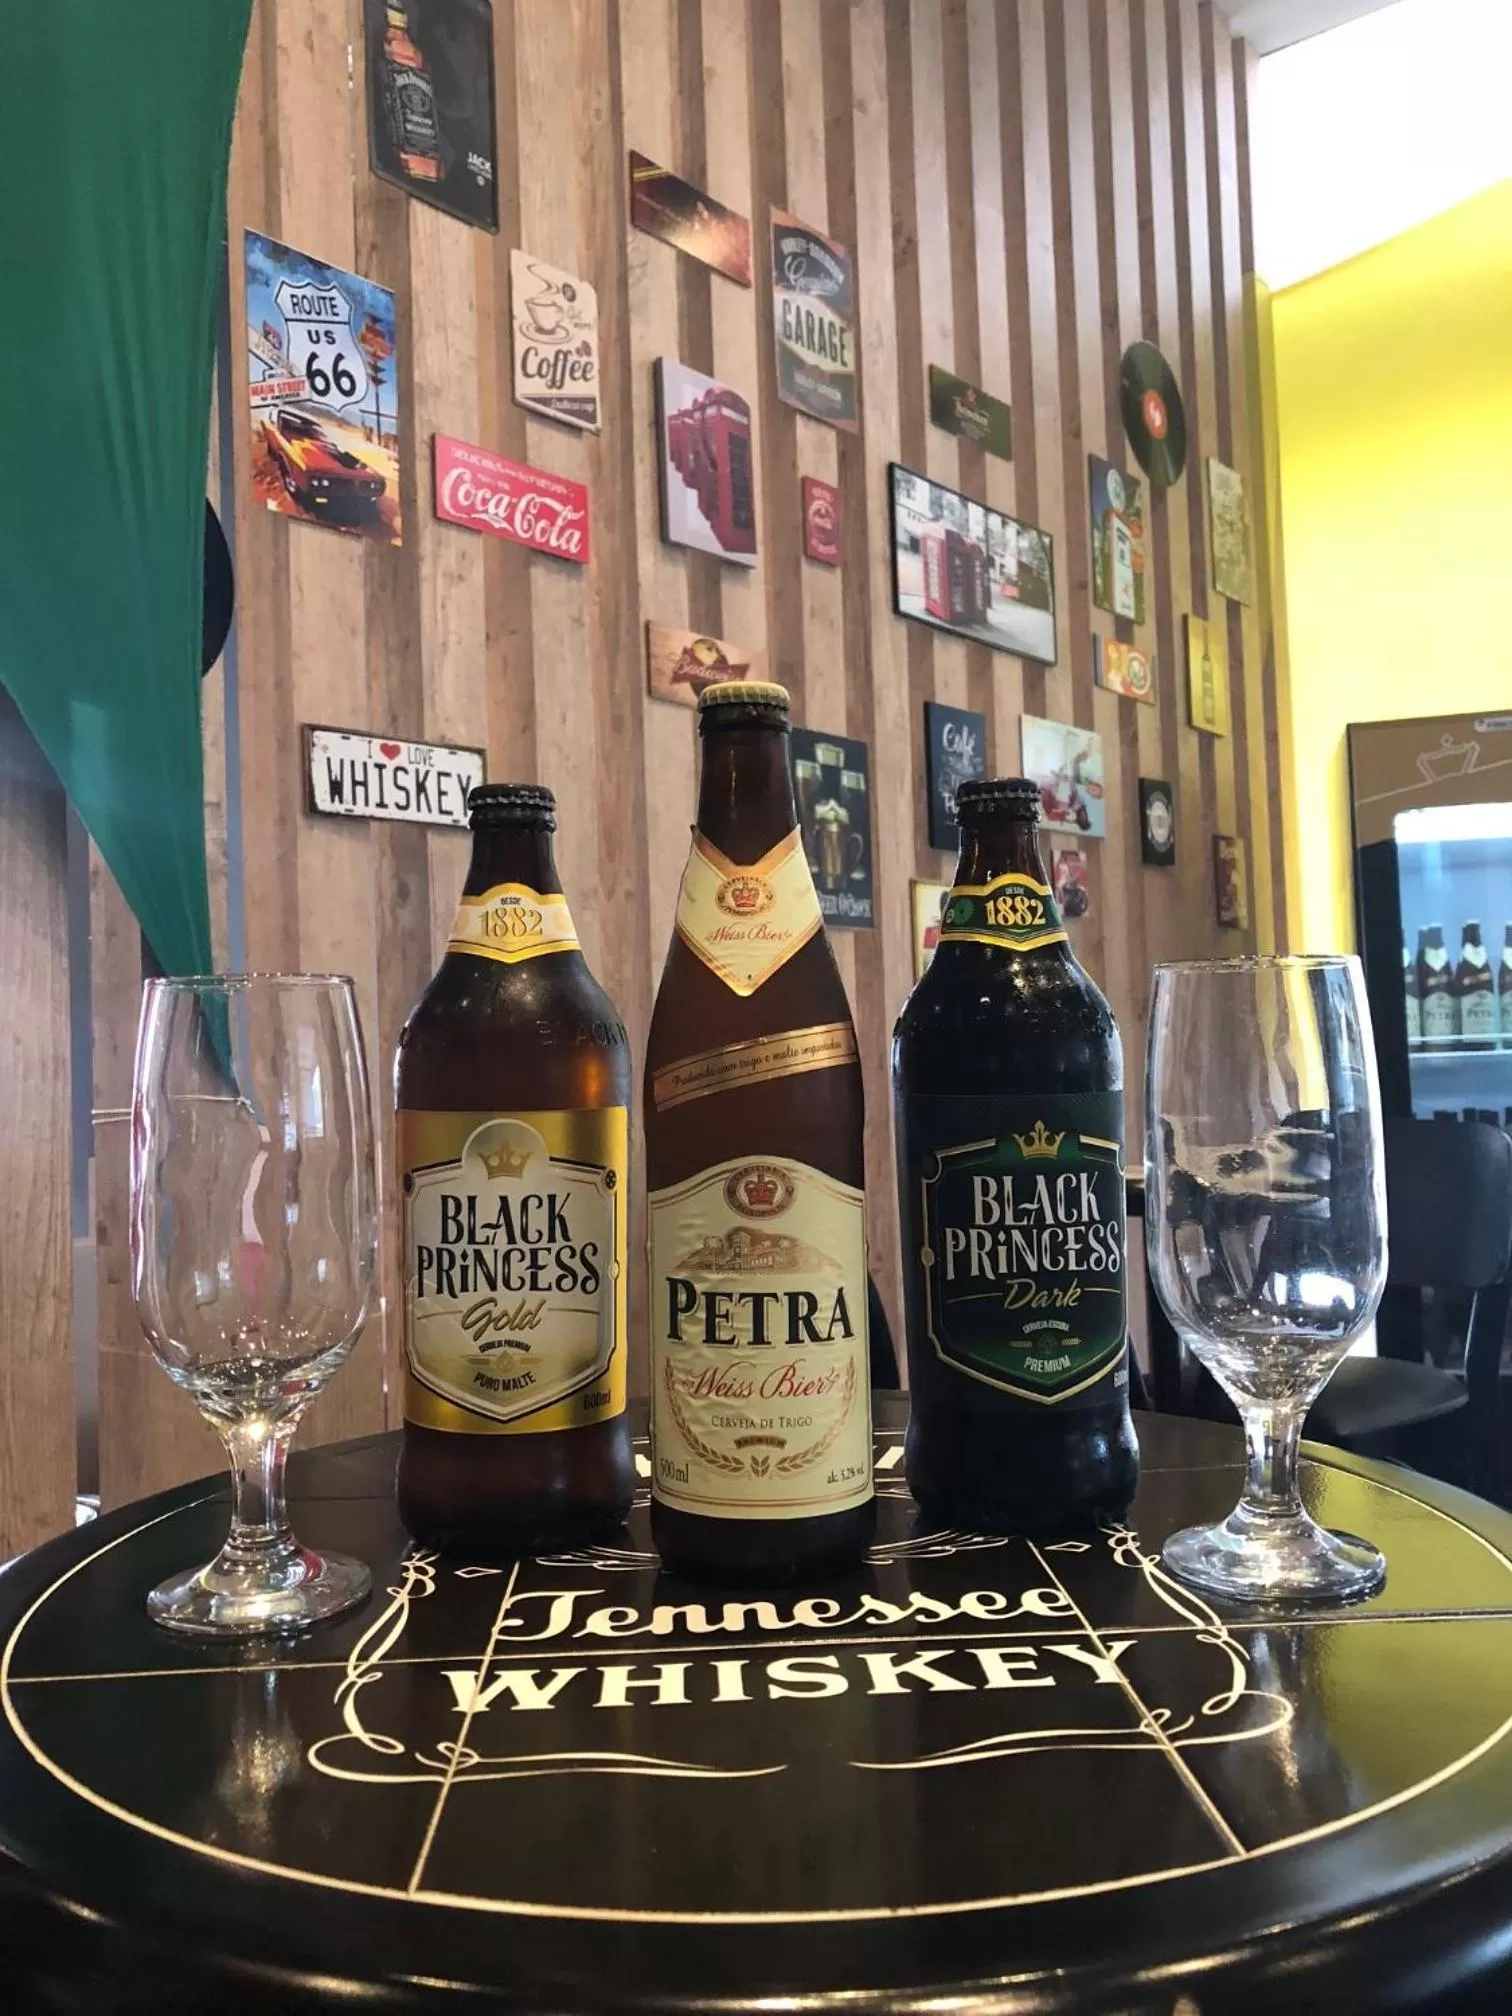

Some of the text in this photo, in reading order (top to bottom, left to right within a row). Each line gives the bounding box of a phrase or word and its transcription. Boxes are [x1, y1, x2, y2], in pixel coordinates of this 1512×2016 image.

[289, 293, 341, 317] ROUTE
[307, 328, 337, 346] US
[781, 297, 848, 368] GARAGE
[305, 351, 357, 398] 66
[520, 346, 596, 390] Coffee
[440, 466, 586, 554] Coca-Cola
[367, 740, 435, 769] I LOVE
[326, 755, 473, 818] WHISKEY
[478, 907, 544, 938] 1882
[704, 920, 746, 944] Weiss
[985, 895, 1046, 927] 1882
[439, 1192, 573, 1246] BLACK
[971, 1170, 1101, 1226] BLACK
[665, 1276, 856, 1346] PETRA
[1003, 1277, 1083, 1311] Dark
[460, 1296, 547, 1343] Gold
[473, 1370, 537, 1392] PURO MALTE
[690, 1358, 824, 1399] Weiss Bier
[1023, 1354, 1072, 1372] PREMIUM
[659, 1457, 690, 1484] 500ml
[497, 1588, 1078, 1640] Tennessee
[440, 1640, 1139, 1713] WHISKEY
